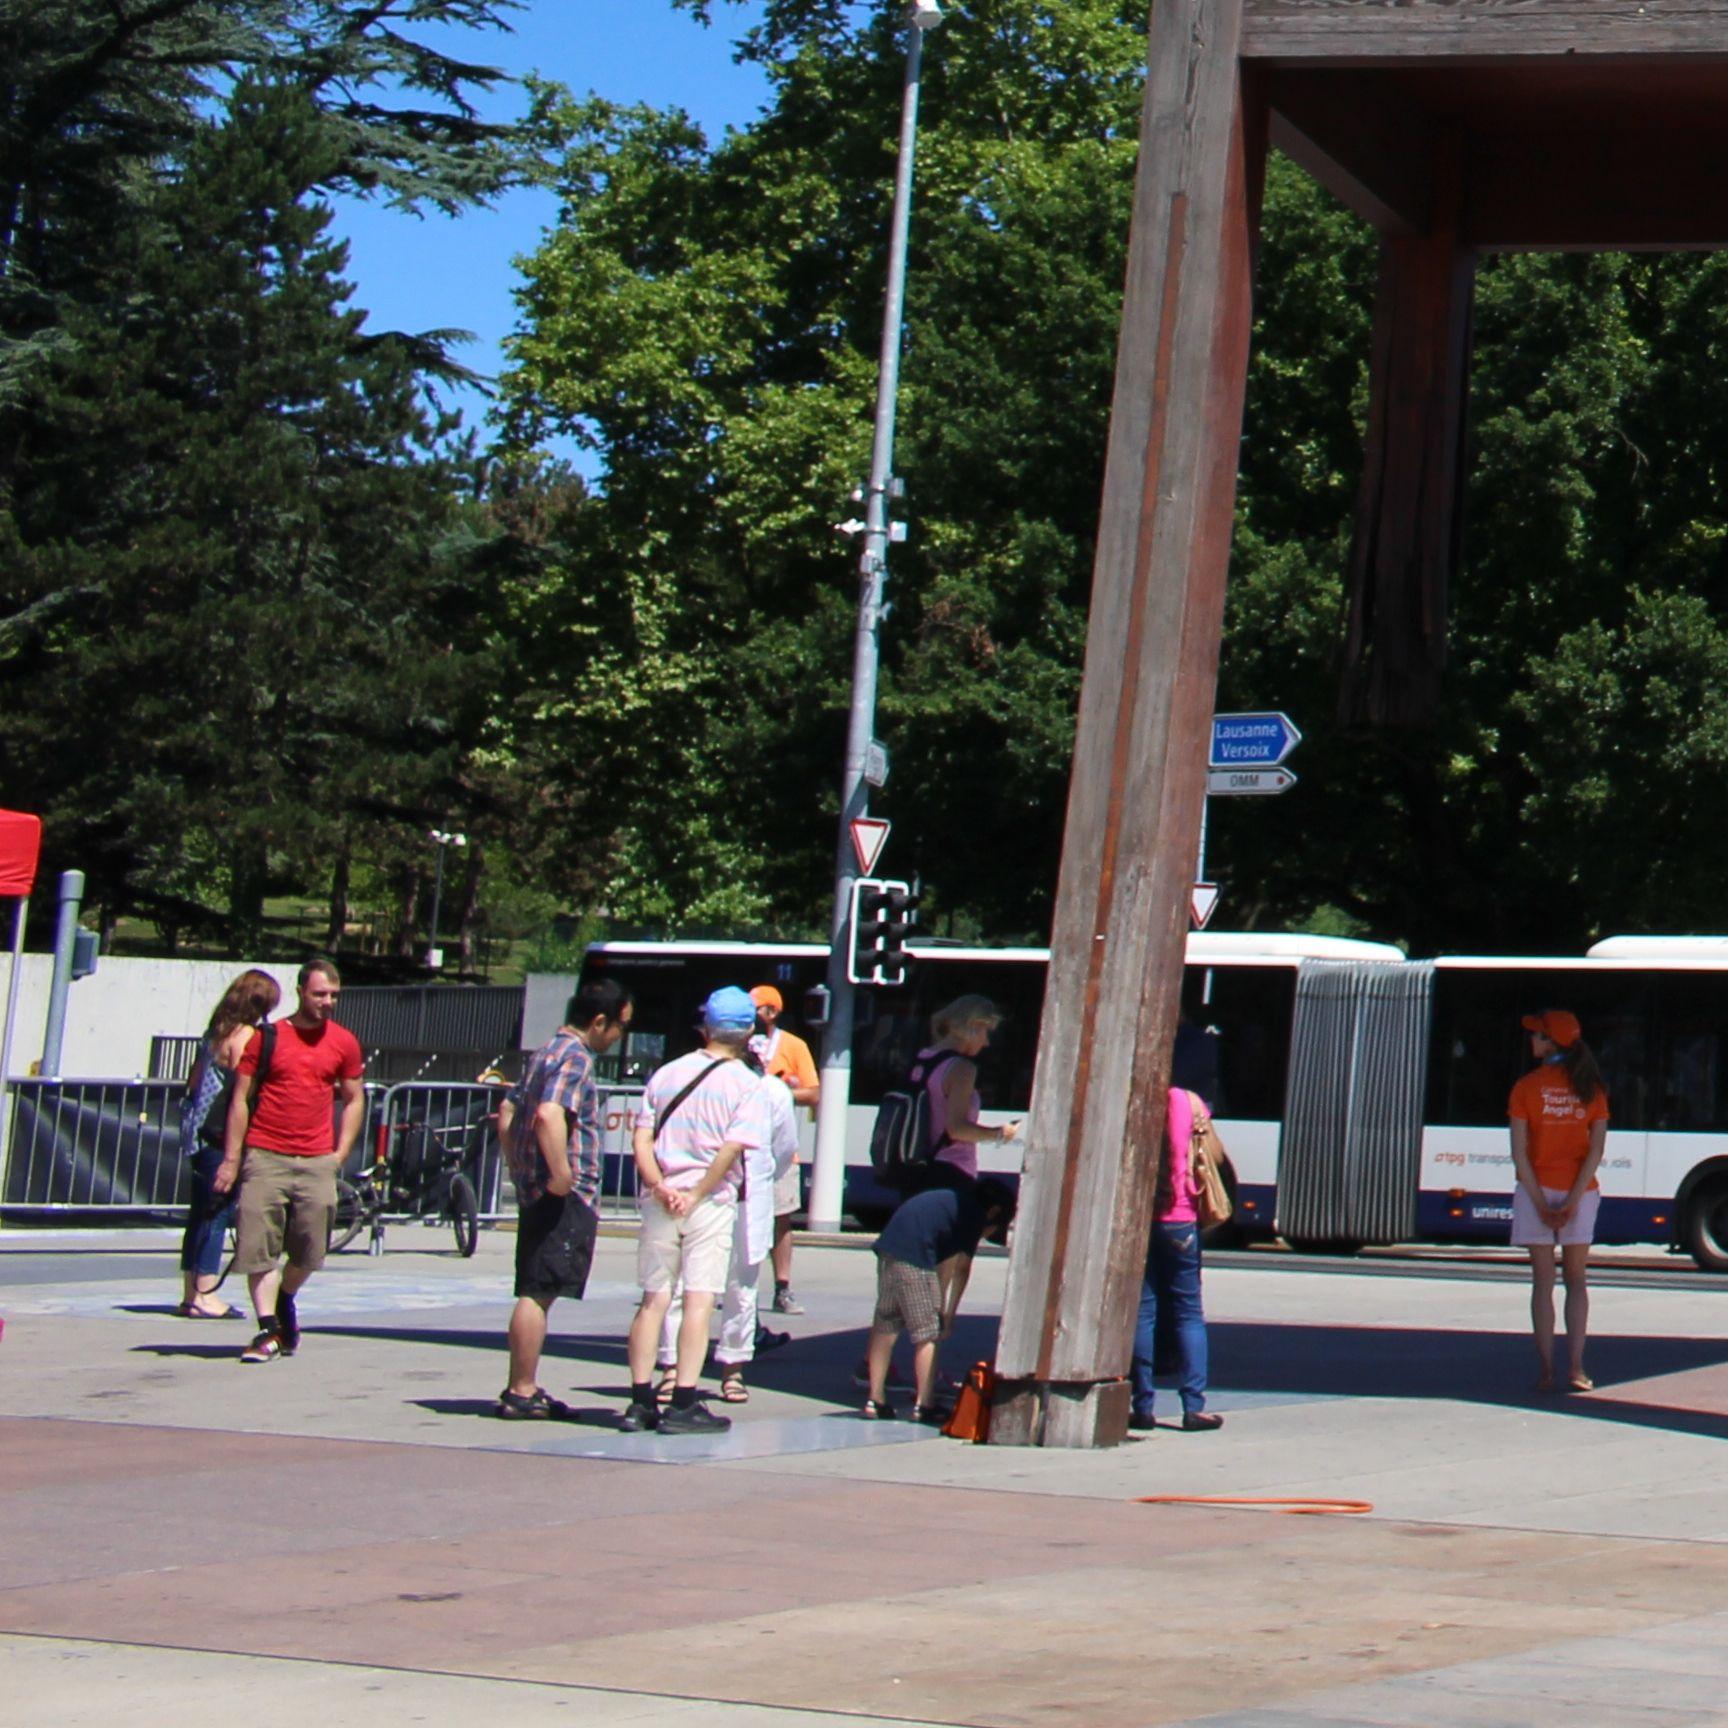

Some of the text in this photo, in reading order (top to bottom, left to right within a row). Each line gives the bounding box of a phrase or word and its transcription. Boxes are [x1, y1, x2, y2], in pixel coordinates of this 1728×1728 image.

[1216, 724, 1278, 739] Lausanne
[1221, 741, 1270, 758] Versoix
[1230, 775, 1259, 787] OMM
[1542, 1104, 1574, 1118] Angel
